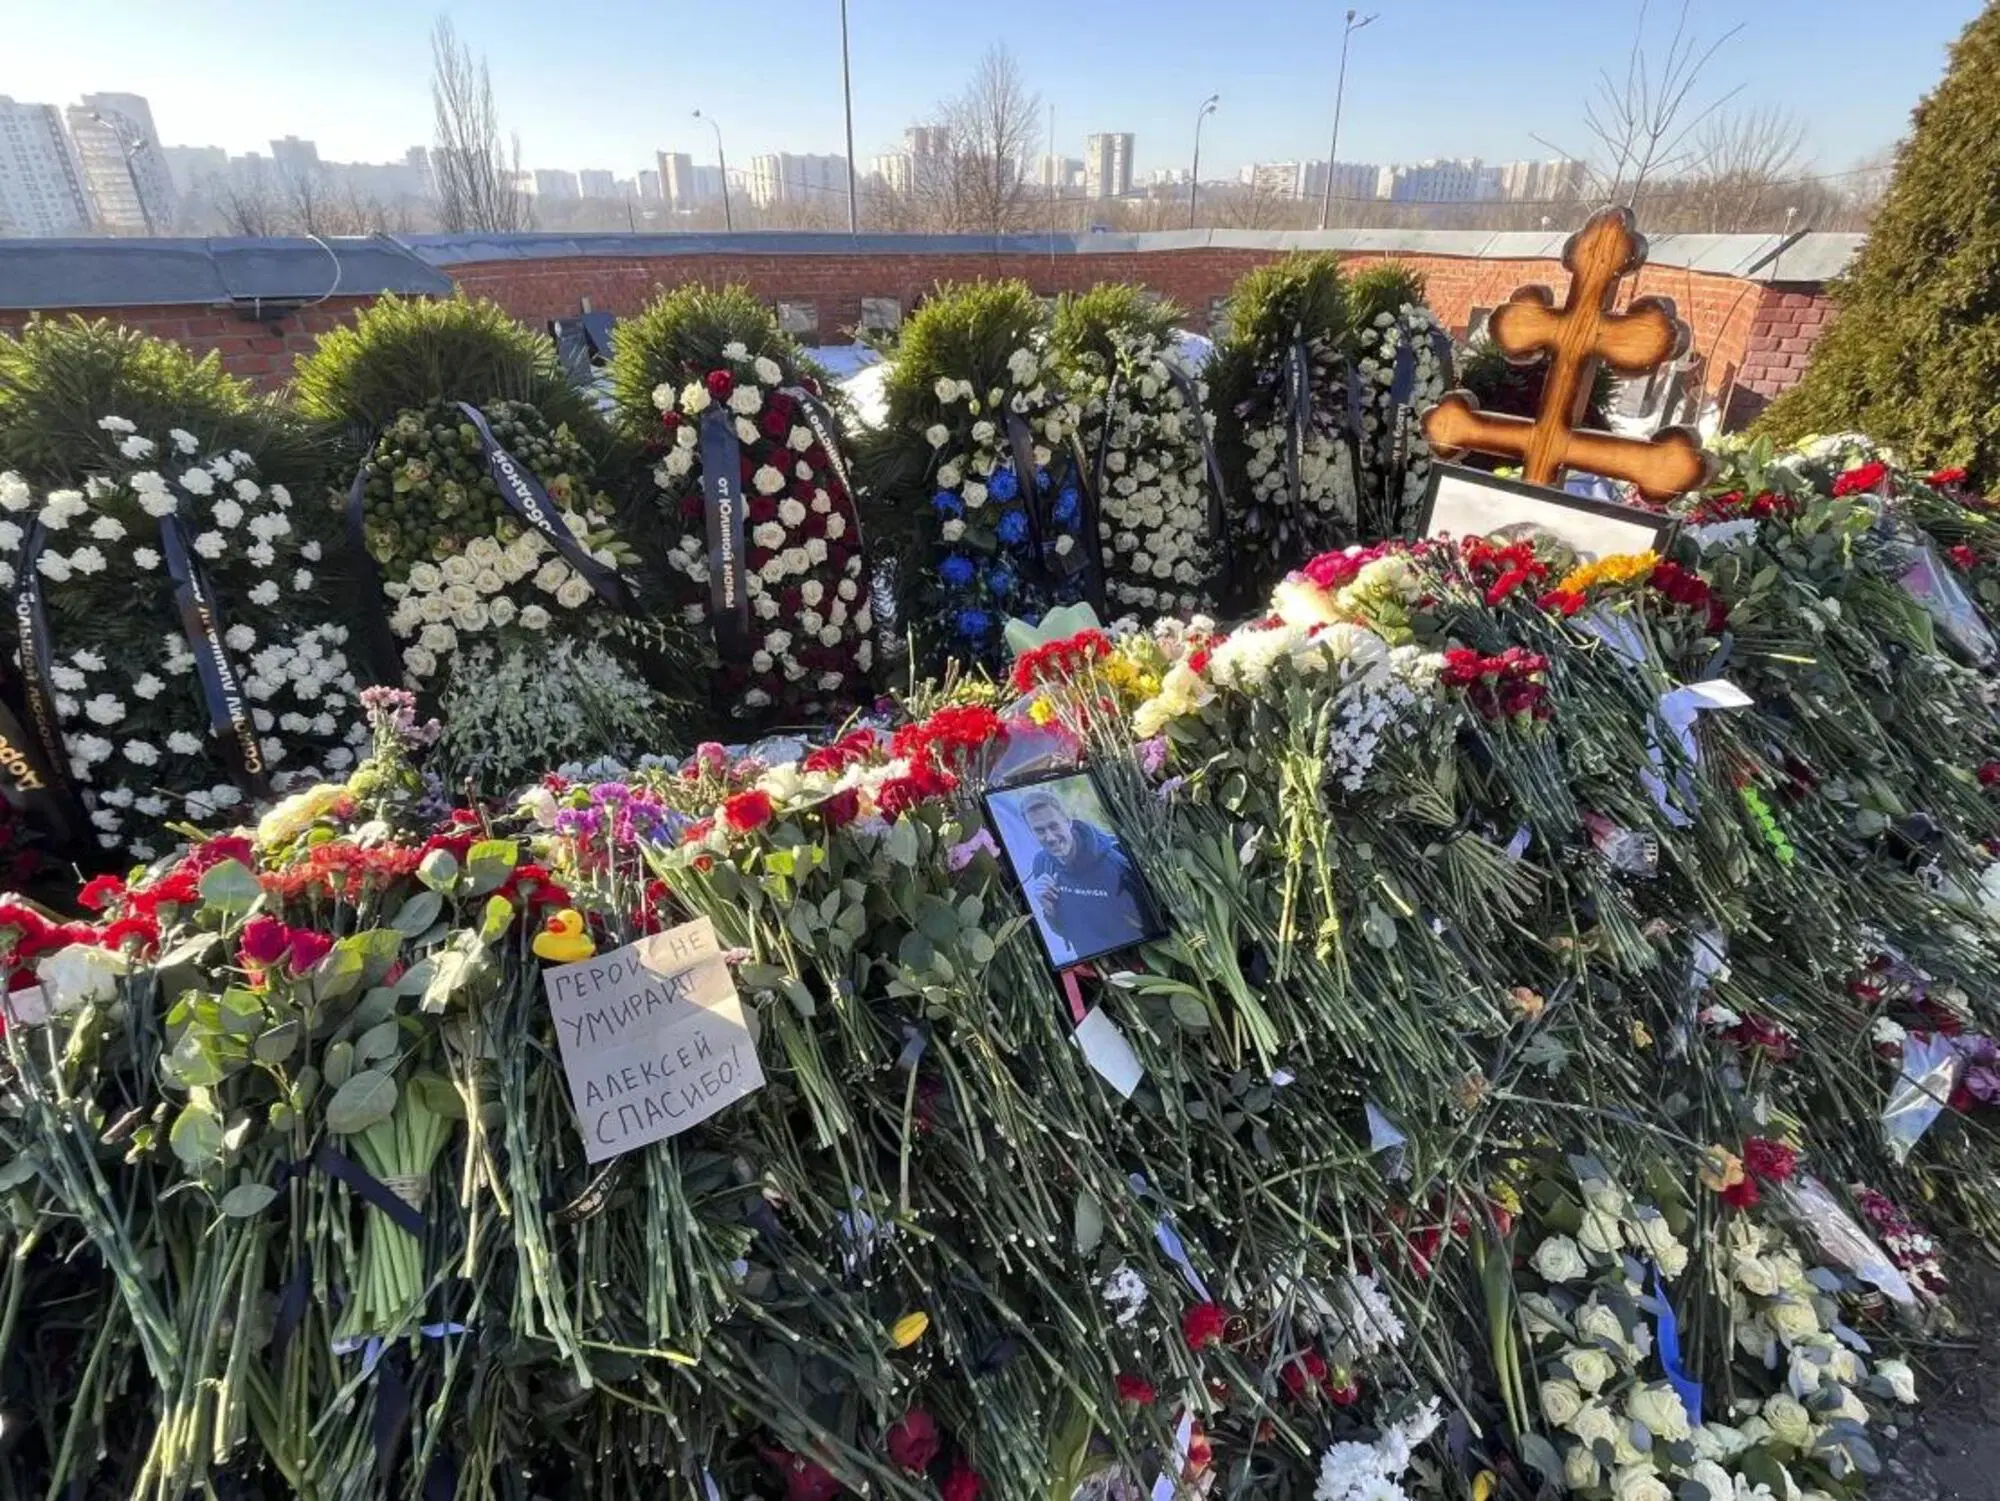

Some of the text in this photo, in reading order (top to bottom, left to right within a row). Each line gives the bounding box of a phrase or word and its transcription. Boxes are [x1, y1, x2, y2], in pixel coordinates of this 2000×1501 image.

[491, 449, 558, 536] ободной
[718, 476, 735, 609] от Юлиной мамы
[225, 696, 262, 774] Самому
[555, 930, 707, 1003] ГЕРОИ НЕ
[586, 1030, 713, 1107] АЛЕКСЕЙ
[596, 1044, 742, 1144] СПАСИБО!
